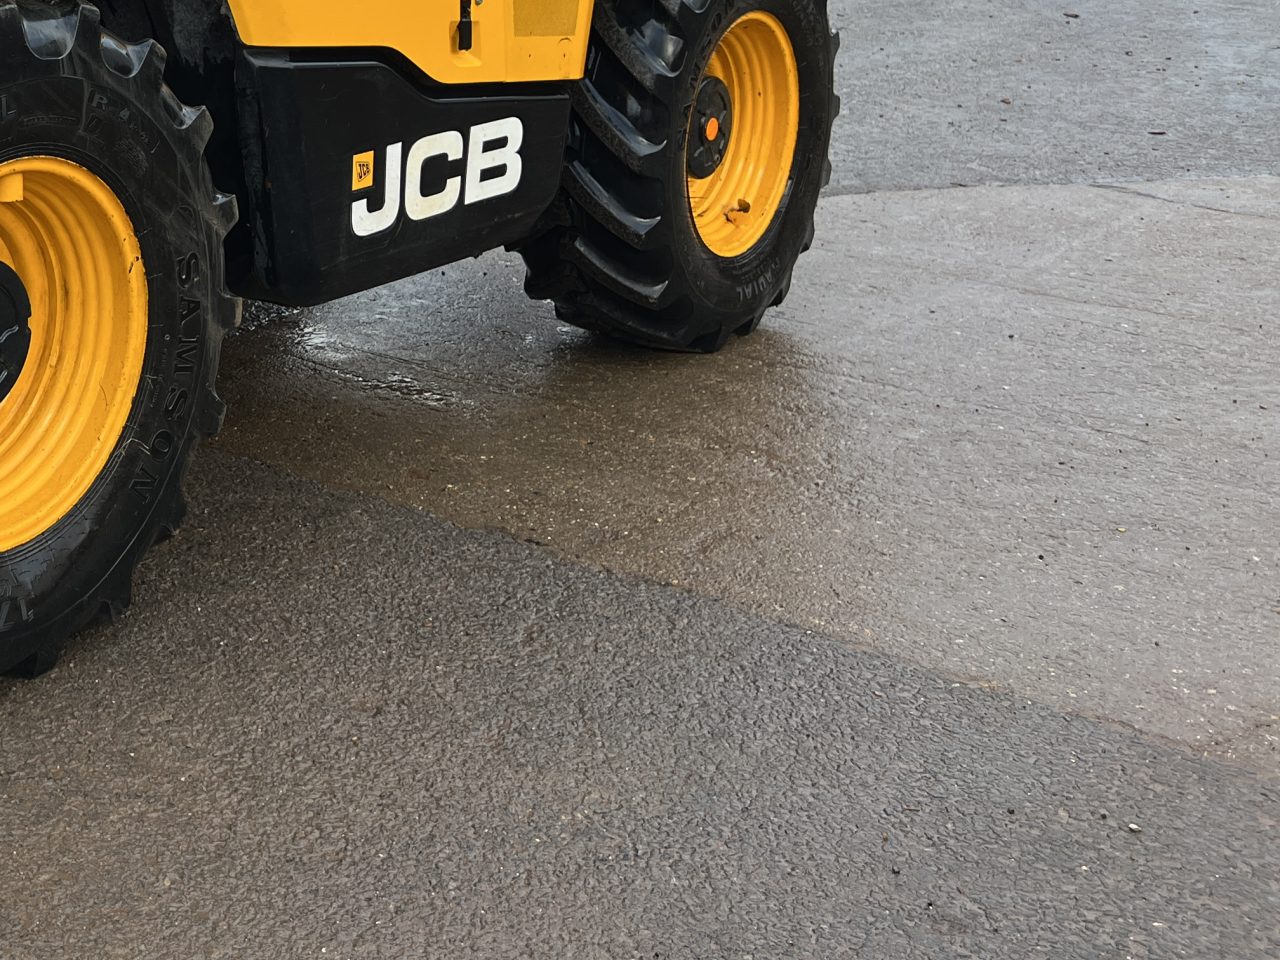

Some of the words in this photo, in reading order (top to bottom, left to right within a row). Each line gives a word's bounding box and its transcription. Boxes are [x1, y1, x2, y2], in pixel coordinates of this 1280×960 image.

[352, 117, 523, 236] JCB
[357, 161, 371, 180] JCB
[129, 251, 200, 504] SAMSON
